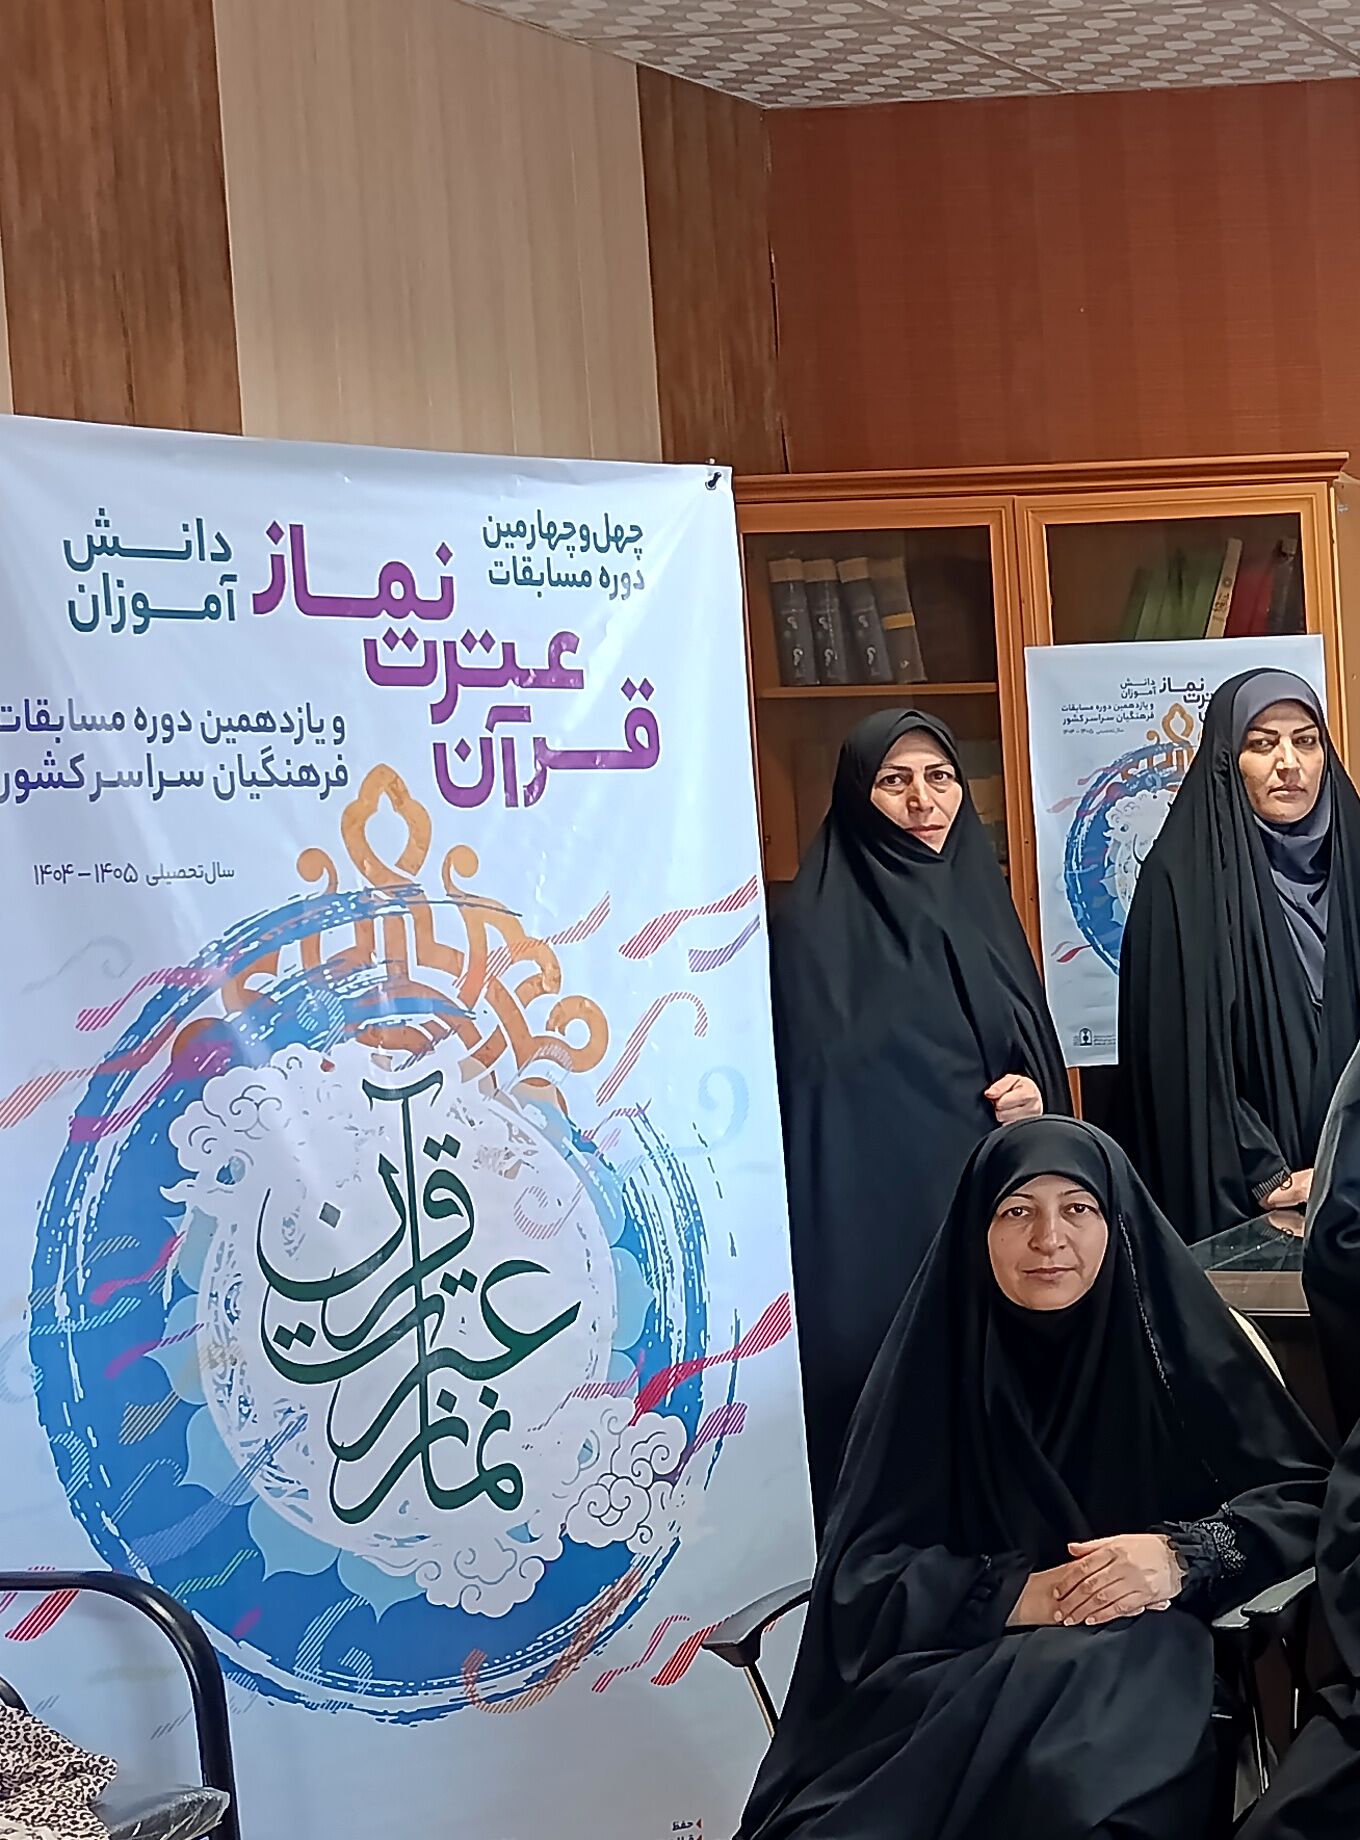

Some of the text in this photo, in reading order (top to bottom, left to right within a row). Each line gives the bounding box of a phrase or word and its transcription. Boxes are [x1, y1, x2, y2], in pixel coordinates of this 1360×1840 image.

[63, 507, 233, 573] دانش
[252, 519, 455, 621] نماز
[67, 572, 238, 635] آموزان
[488, 555, 645, 601] دوره مسابقات
[362, 626, 585, 725] عترت
[1120, 678, 1156, 690] دانش
[1159, 677, 1205, 693] نماز
[0, 698, 346, 745] و یازدهمین دوره مسابقات
[432, 676, 661, 809] قرآن
[0, 745, 349, 804] فرهنگیان سراسر کشور
